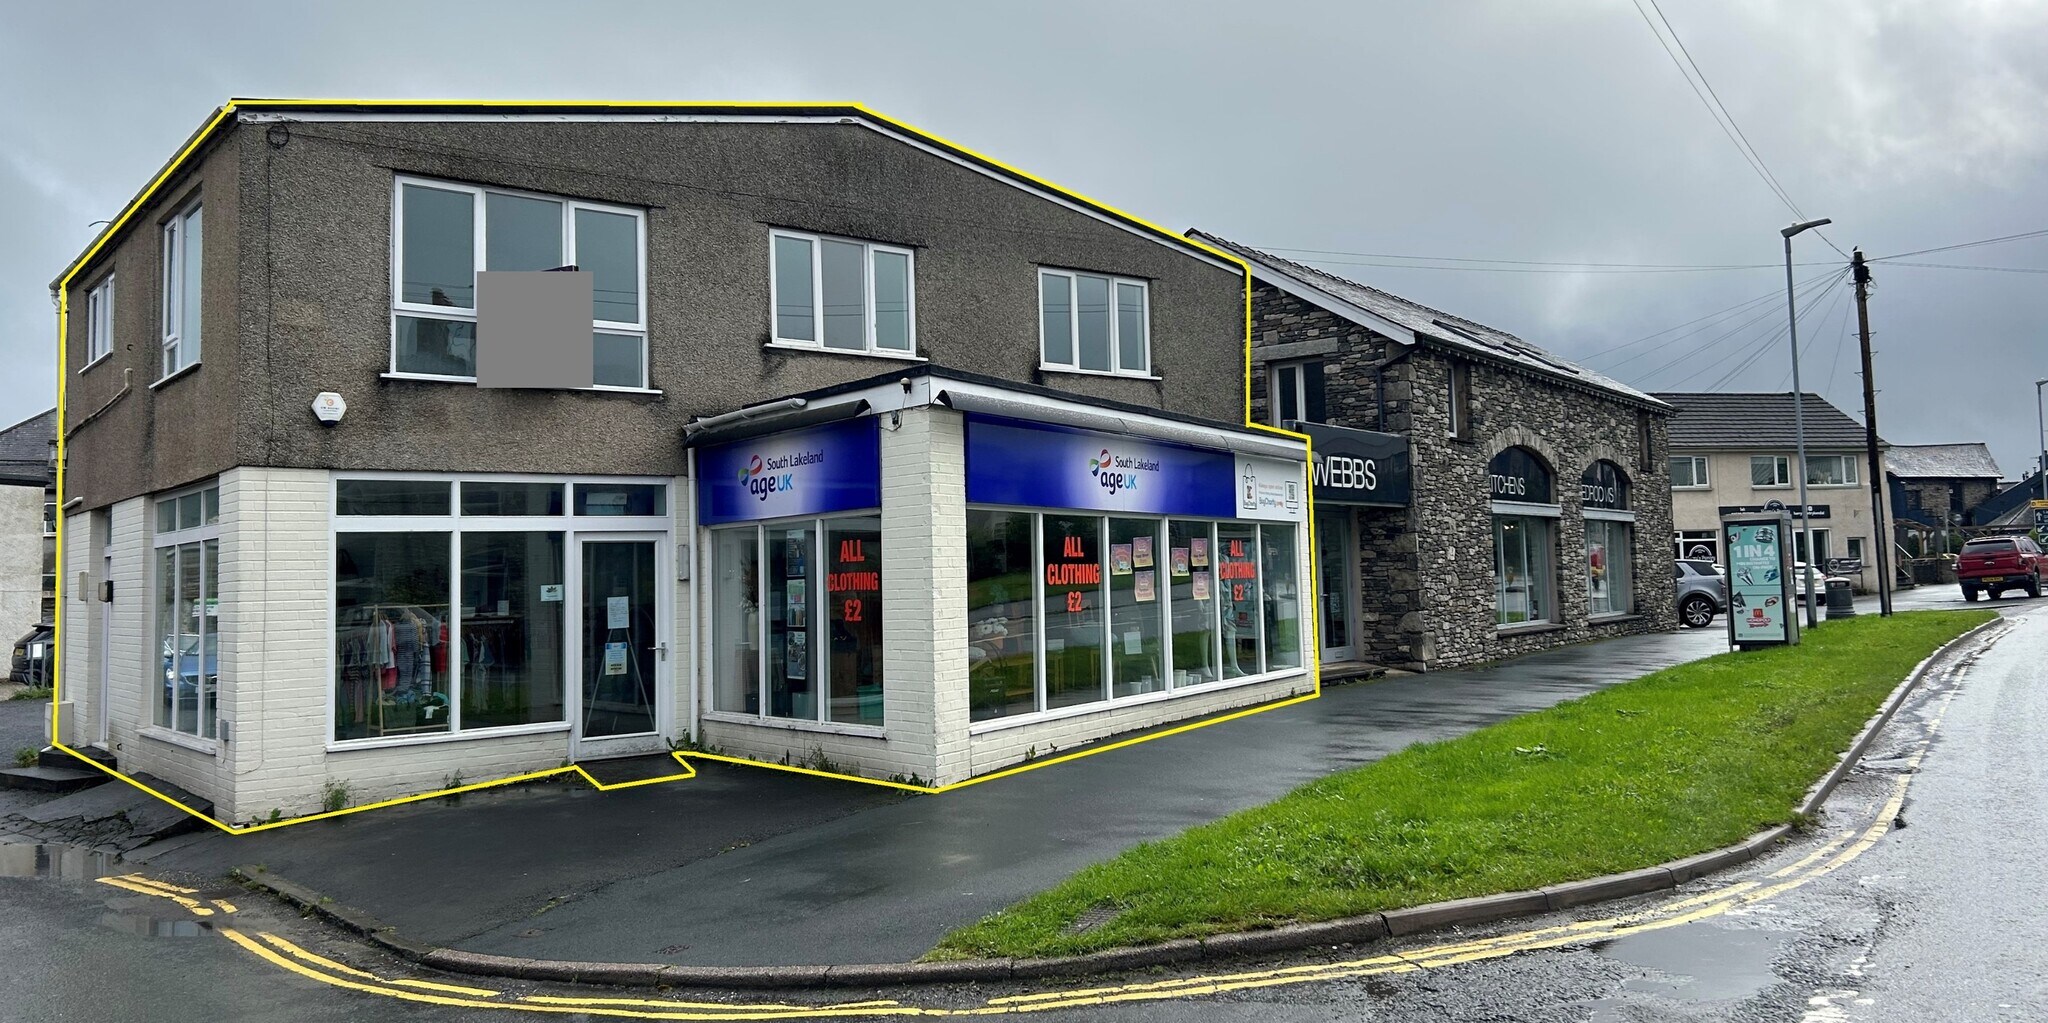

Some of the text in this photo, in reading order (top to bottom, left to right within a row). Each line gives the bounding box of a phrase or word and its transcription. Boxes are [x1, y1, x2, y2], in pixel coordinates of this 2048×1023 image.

[767, 449, 824, 470] South Lakeland
[1115, 456, 1160, 472] South Lakeland
[1310, 455, 1377, 490] WEBBS
[1489, 474, 1526, 496] ITCHENS
[1581, 484, 1615, 503] EDROOMS
[840, 539, 865, 562] ALL
[1063, 536, 1084, 557] ALL
[1230, 540, 1245, 557] ALL
[1733, 544, 1776, 558] 1 IN 4
[1047, 563, 1100, 585] CLOTHING
[1220, 562, 1255, 579] CLOTHING
[826, 571, 879, 592] CLOTHING
[1067, 591, 1083, 612] £2
[1233, 584, 1245, 601] £2
[844, 599, 863, 622] £2
